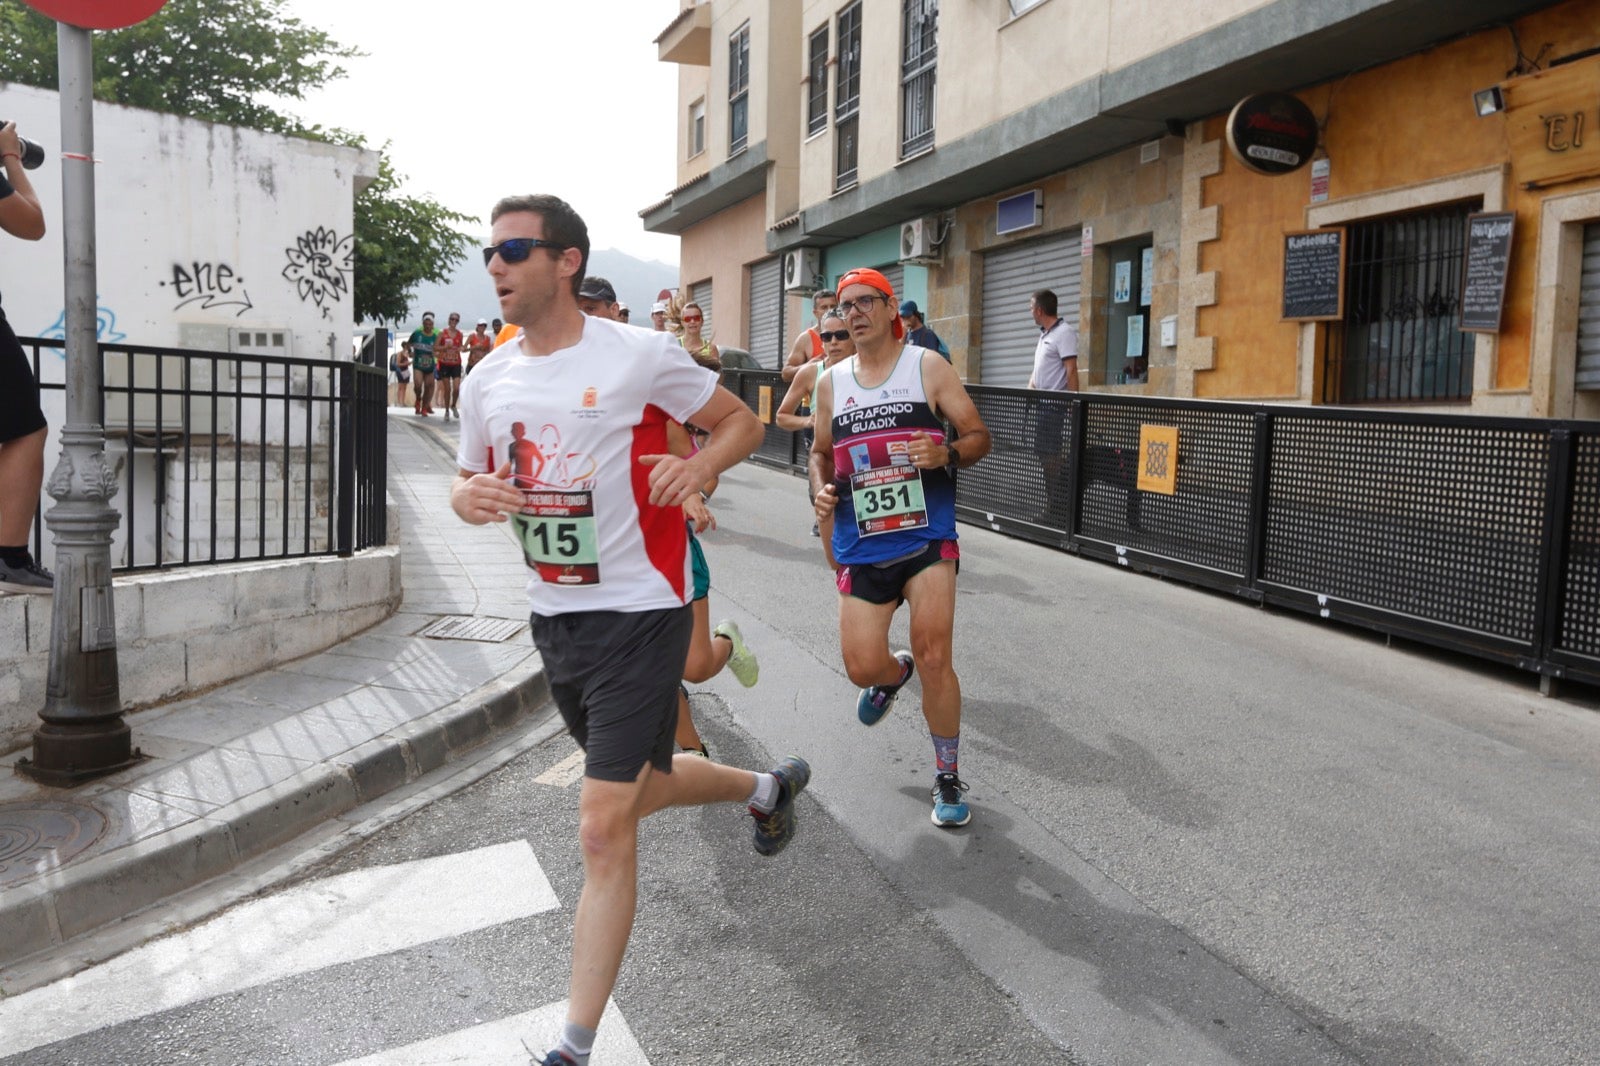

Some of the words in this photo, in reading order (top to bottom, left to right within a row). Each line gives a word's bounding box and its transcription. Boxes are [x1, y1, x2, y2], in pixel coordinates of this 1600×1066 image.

[838, 403, 913, 426] ULTRAFONDO
[851, 416, 897, 433] GUADIX
[875, 468, 893, 479] PREMIO
[893, 467, 900, 476] DE
[527, 494, 554, 506] PREMIO
[554, 494, 563, 506] DE
[563, 494, 588, 506] FONDO
[863, 484, 911, 514] 351
[515, 517, 580, 557] 715
